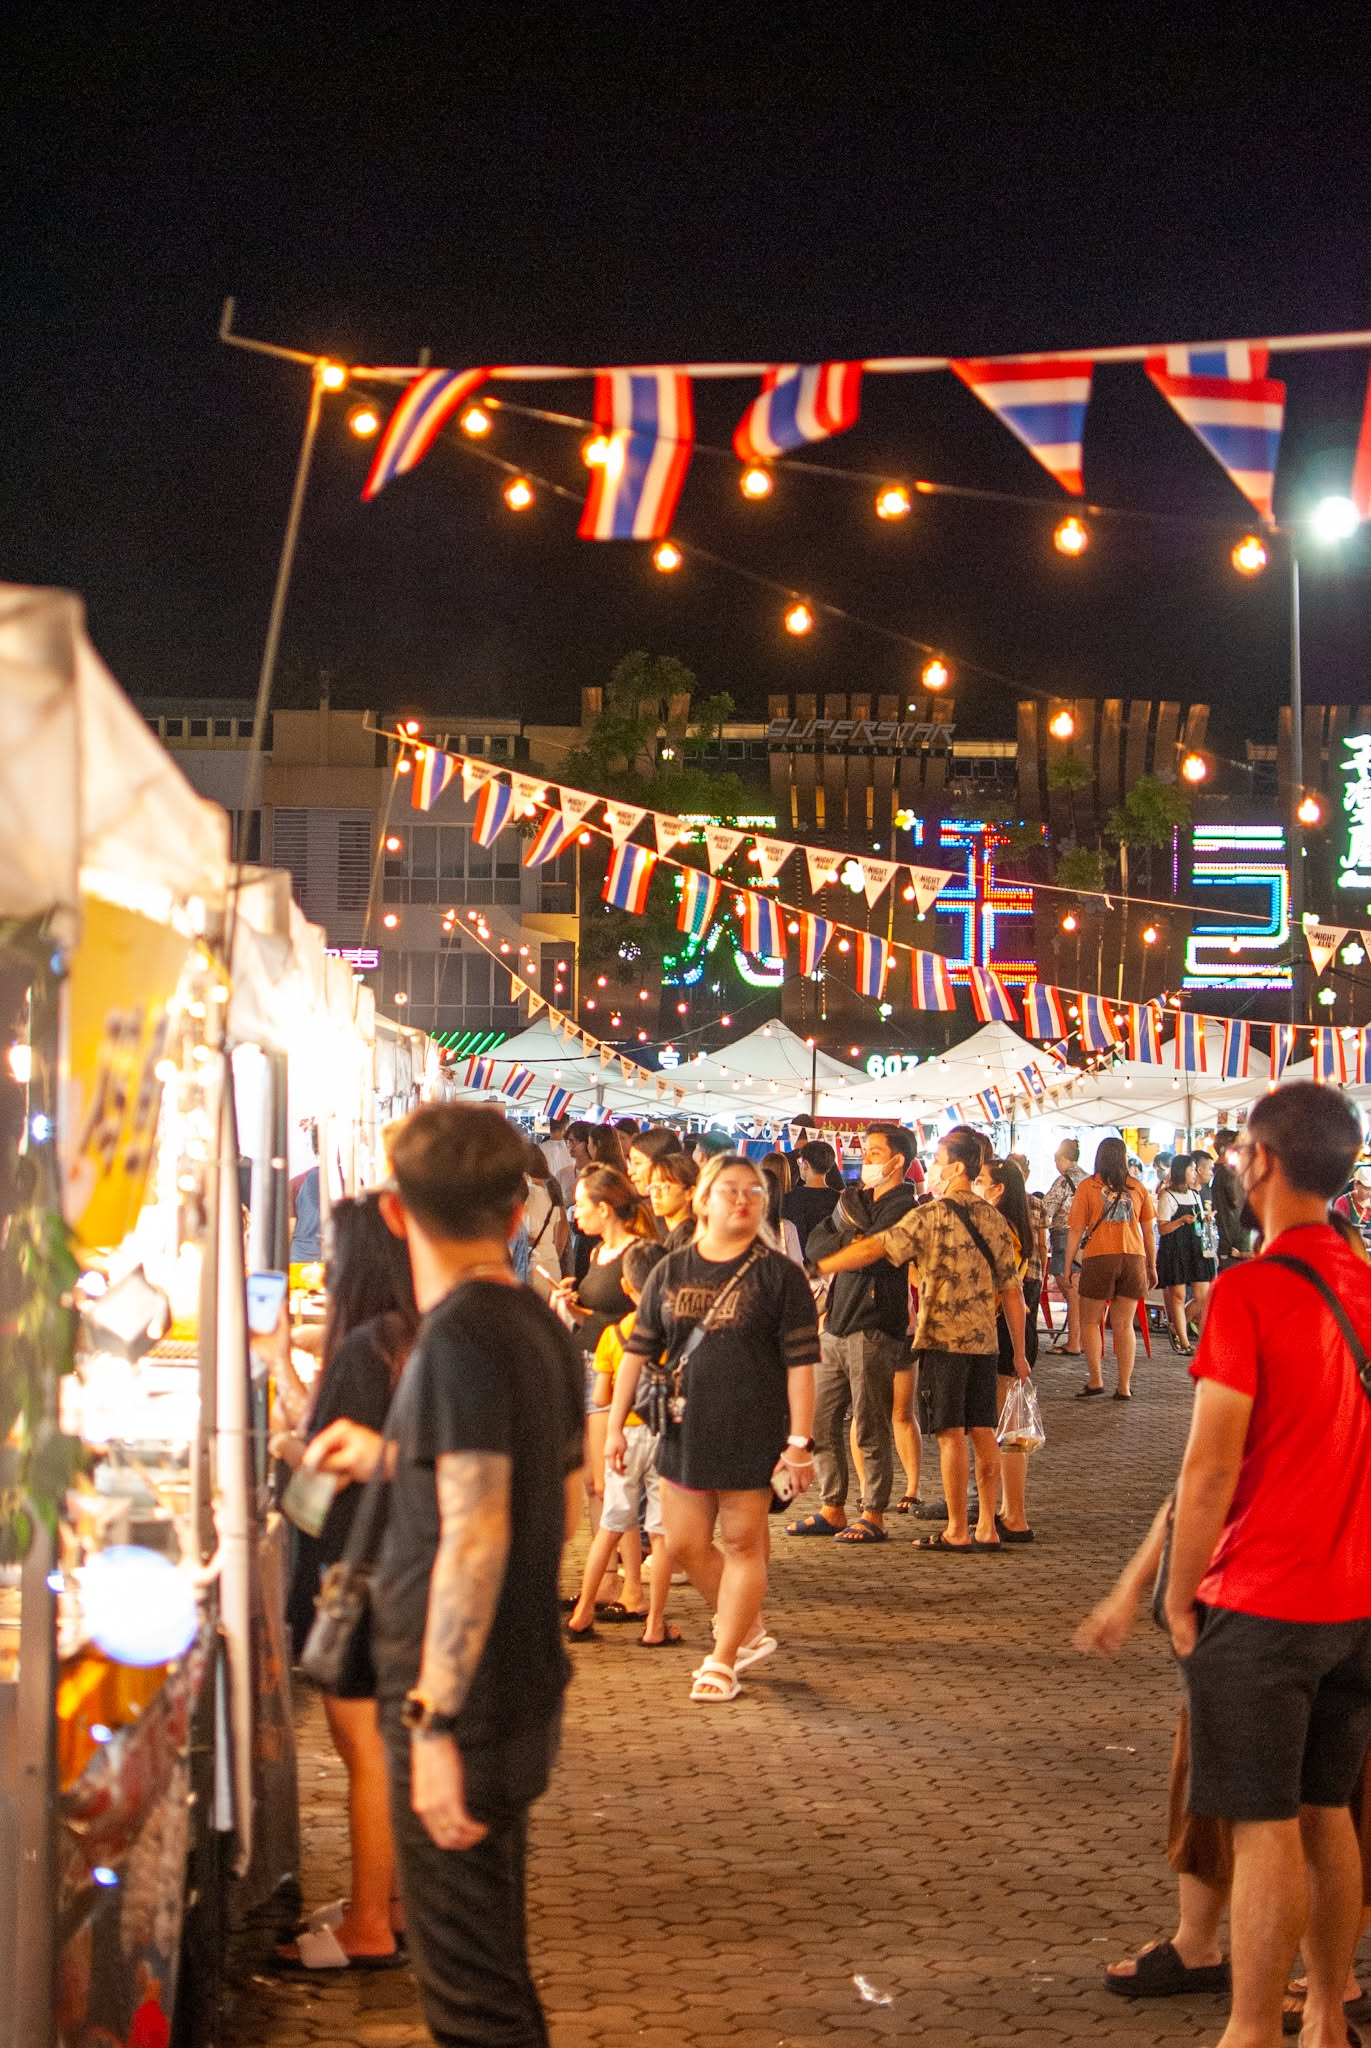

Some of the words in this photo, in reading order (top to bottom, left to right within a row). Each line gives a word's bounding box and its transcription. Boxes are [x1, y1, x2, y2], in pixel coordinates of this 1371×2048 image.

[768, 718, 957, 745] SUPERSTAR
[767, 744, 843, 753] FAMILY
[713, 835, 734, 845] NIGHT
[764, 846, 785, 856] NIGHT
[814, 855, 835, 865] NIGHT
[868, 865, 888, 876] NIGHT
[920, 875, 940, 885] NIGHT
[1314, 931, 1337, 943] NIGHT
[866, 1054, 920, 1080] 607
